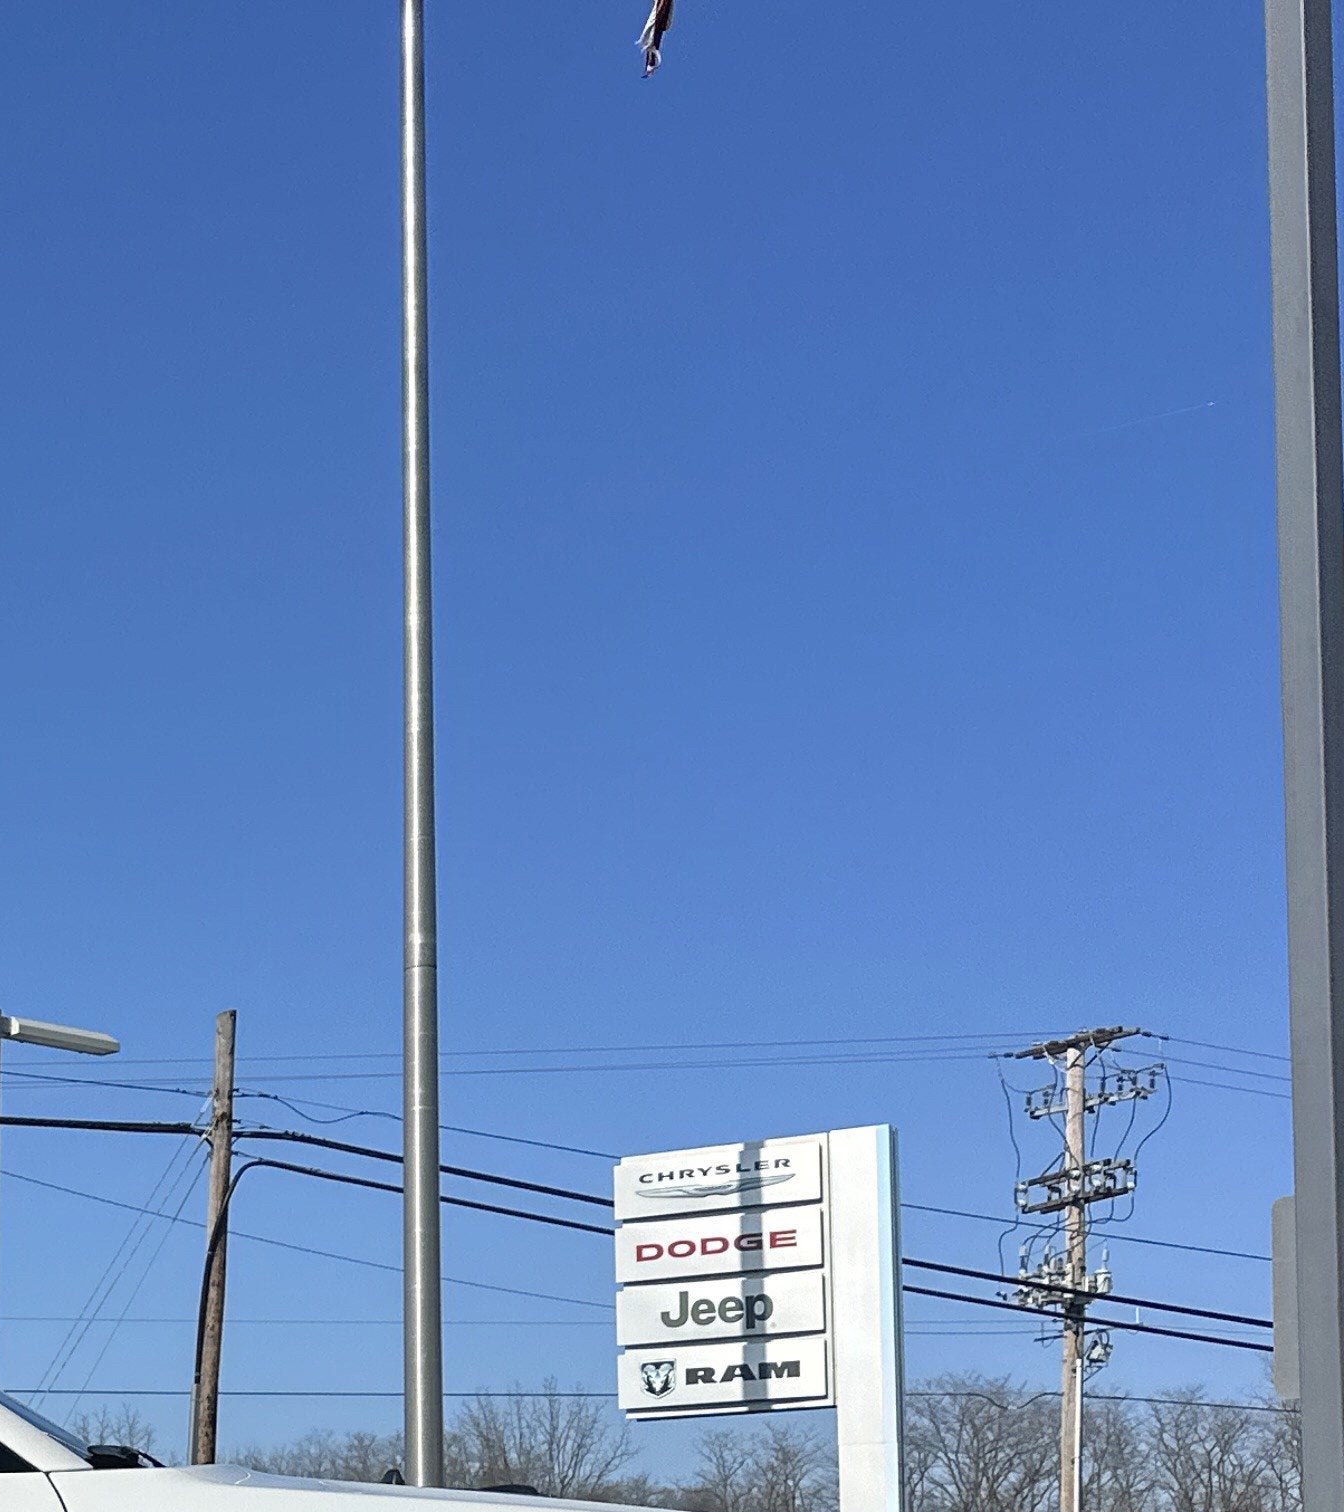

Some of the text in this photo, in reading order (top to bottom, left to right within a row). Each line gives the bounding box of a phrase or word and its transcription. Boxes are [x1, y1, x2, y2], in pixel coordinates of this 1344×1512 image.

[639, 1158, 791, 1184] CHRYSLER
[636, 1229, 798, 1262] DODGE
[660, 1290, 774, 1329] Jeep
[685, 1360, 801, 1385] RAM
